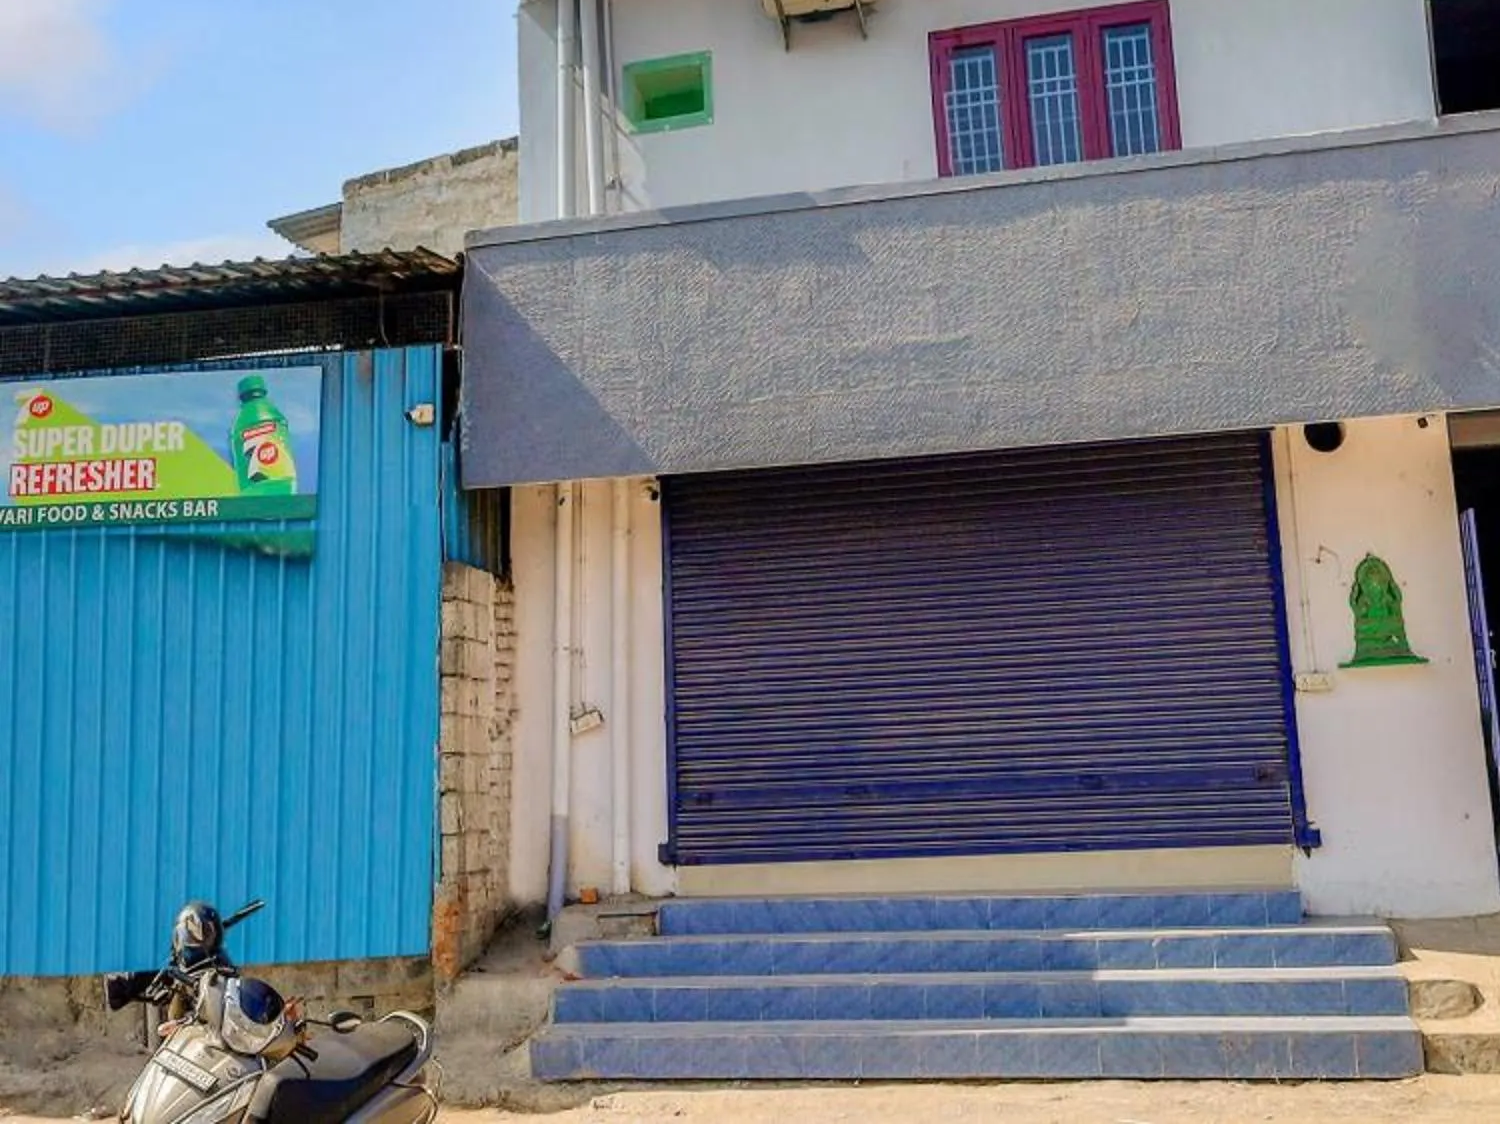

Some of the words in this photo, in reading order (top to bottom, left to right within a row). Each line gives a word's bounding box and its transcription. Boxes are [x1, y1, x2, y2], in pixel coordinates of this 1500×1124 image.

[12, 427, 95, 459] SUPER
[101, 421, 185, 454] DUPER
[37, 505, 88, 524] FOOD
[91, 504, 105, 521] &
[109, 501, 178, 519] SNACKS
[183, 500, 219, 517] BAR
